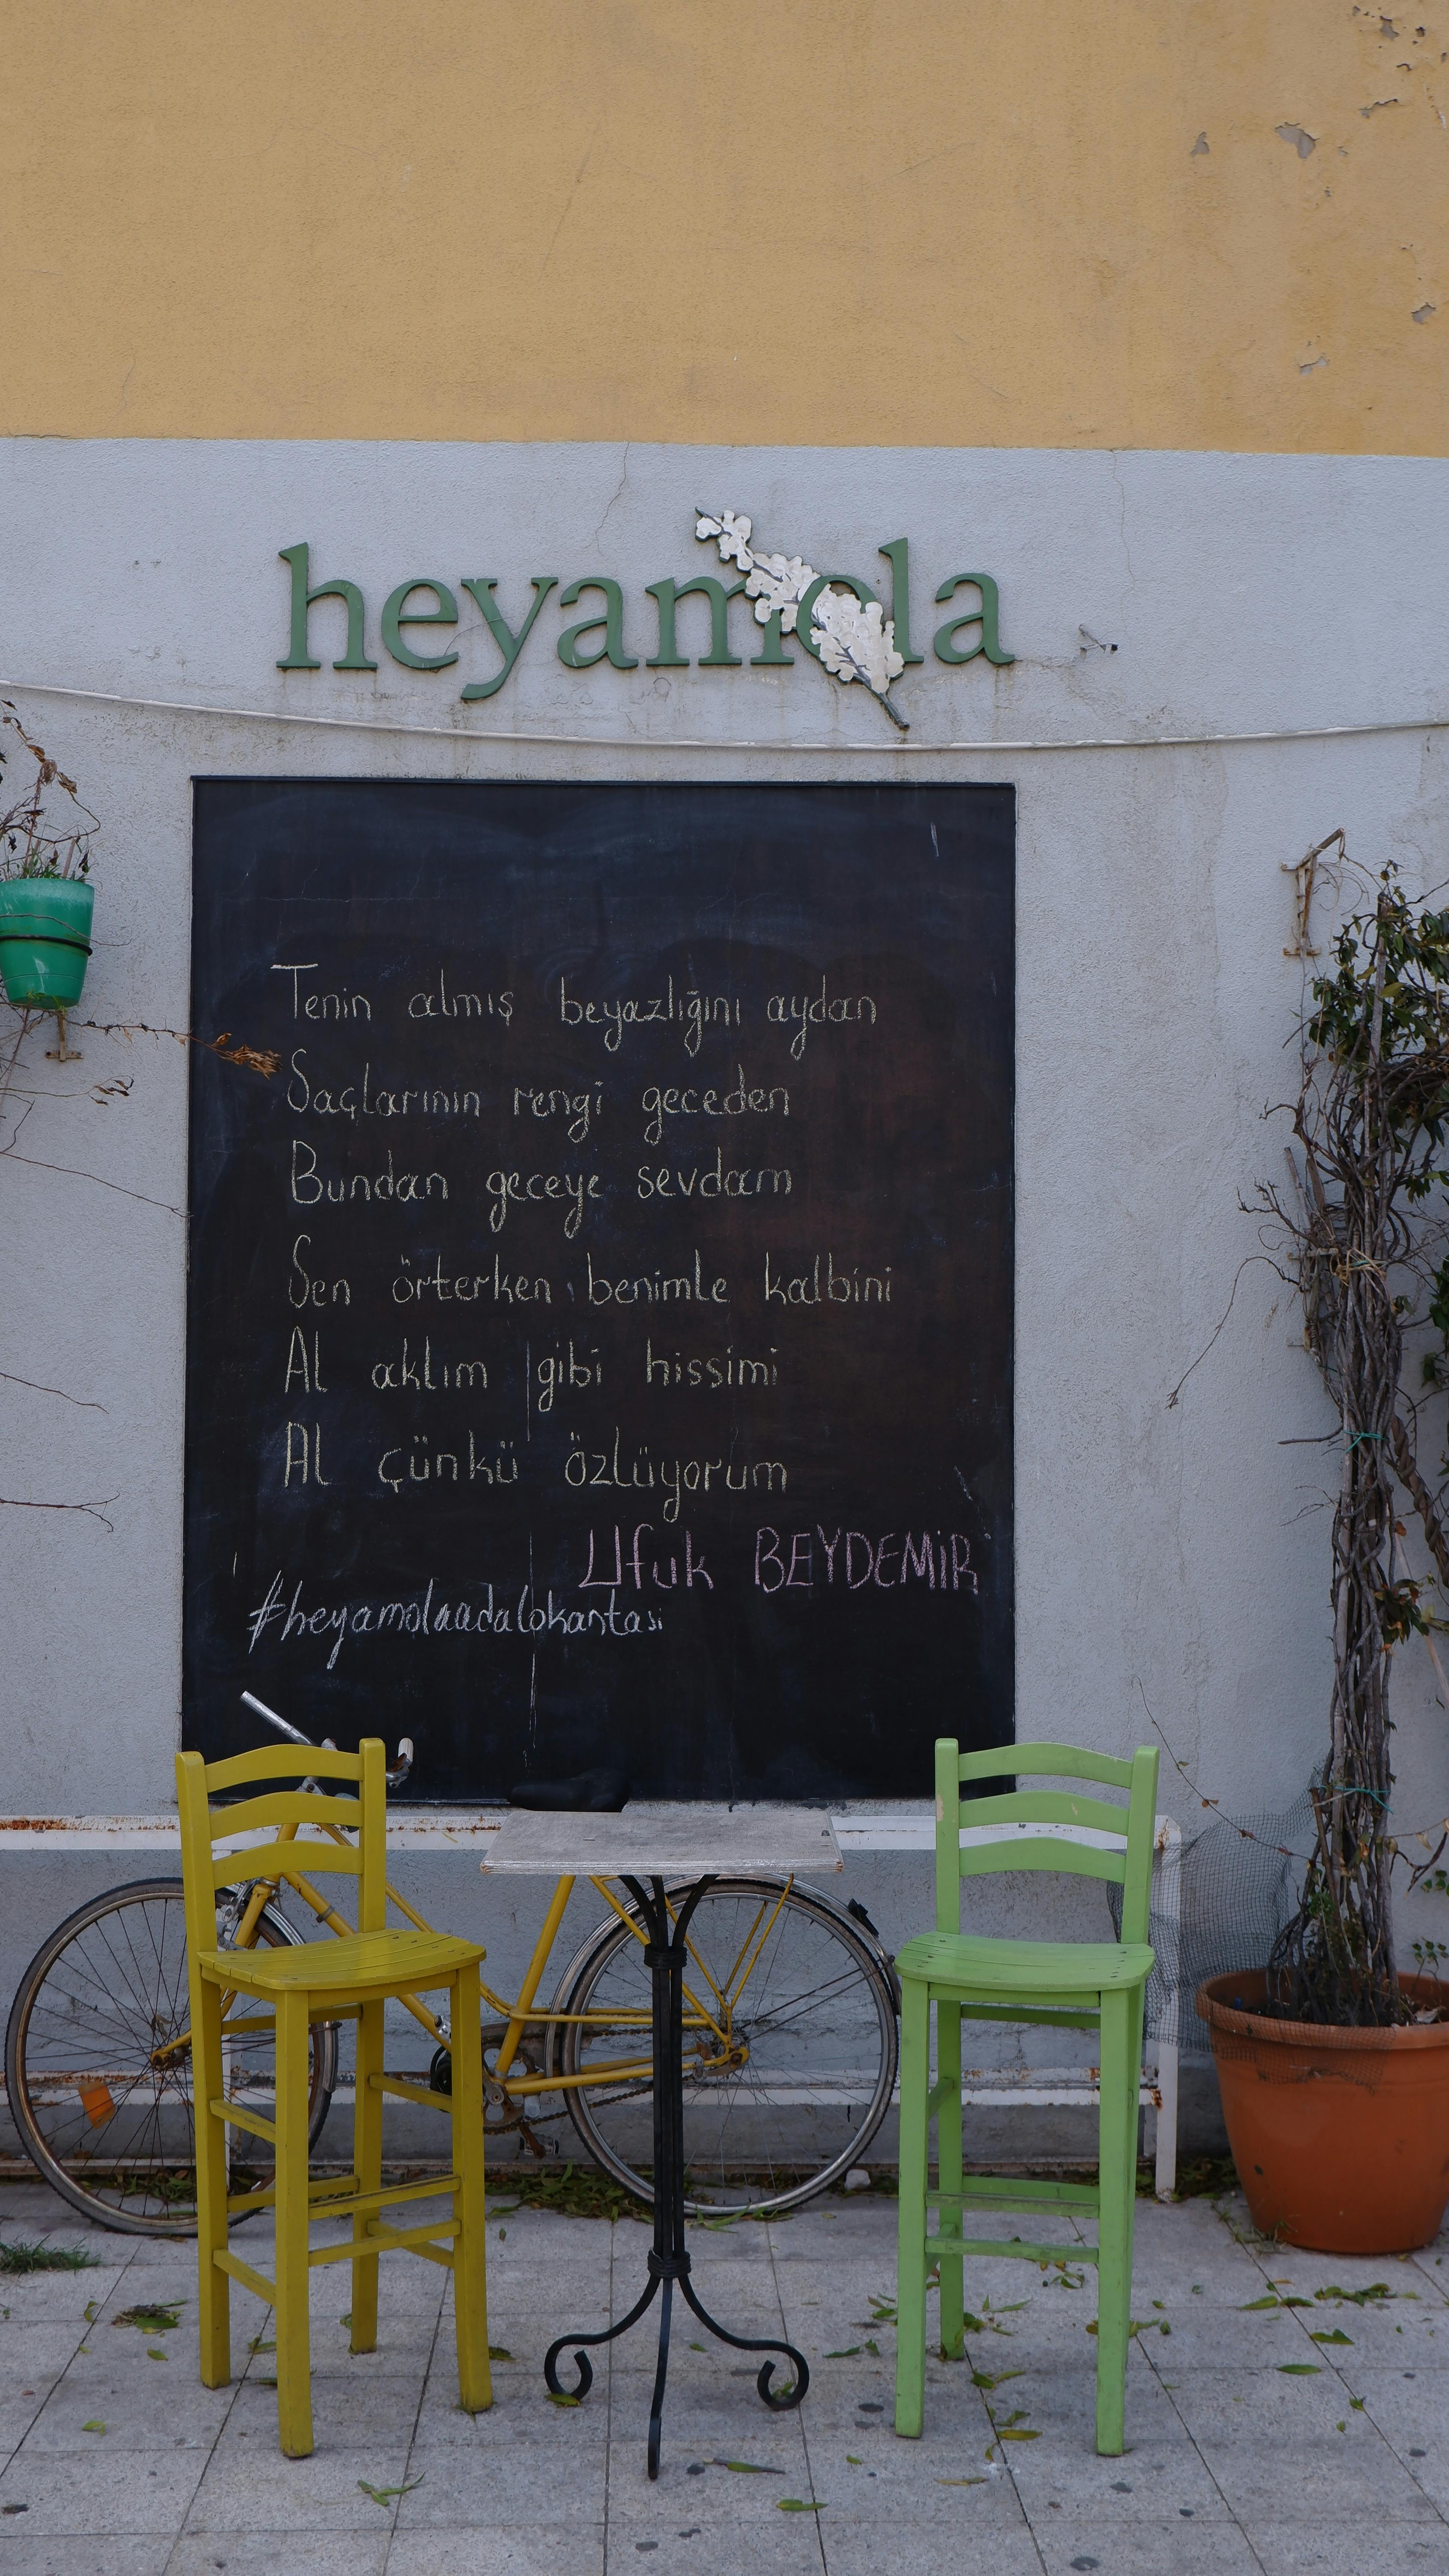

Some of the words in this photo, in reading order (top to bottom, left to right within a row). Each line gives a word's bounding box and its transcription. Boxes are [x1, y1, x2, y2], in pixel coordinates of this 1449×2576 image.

[270, 963, 371, 1021] Tenin
[408, 969, 514, 1026] almış
[767, 974, 876, 1060] aydan
[287, 1048, 480, 1120] Saçlarının
[514, 1081, 603, 1143] rengi
[641, 1064, 789, 1145] geceden
[291, 1140, 449, 1203] Bundan
[486, 1171, 603, 1239] geceye
[637, 1146, 792, 1199] sevdam
[288, 1234, 350, 1308] Sen
[392, 1254, 552, 1304] örterken
[587, 1252, 730, 1305] benimle
[765, 1251, 893, 1305] kalbini
[285, 1326, 329, 1394] Al
[372, 1336, 488, 1390] aklım
[537, 1338, 602, 1413] gibi
[646, 1337, 779, 1388] hissimi
[285, 1421, 332, 1488] Al
[378, 1430, 518, 1493] çünkü
[564, 1426, 787, 1522] özlüyorum
